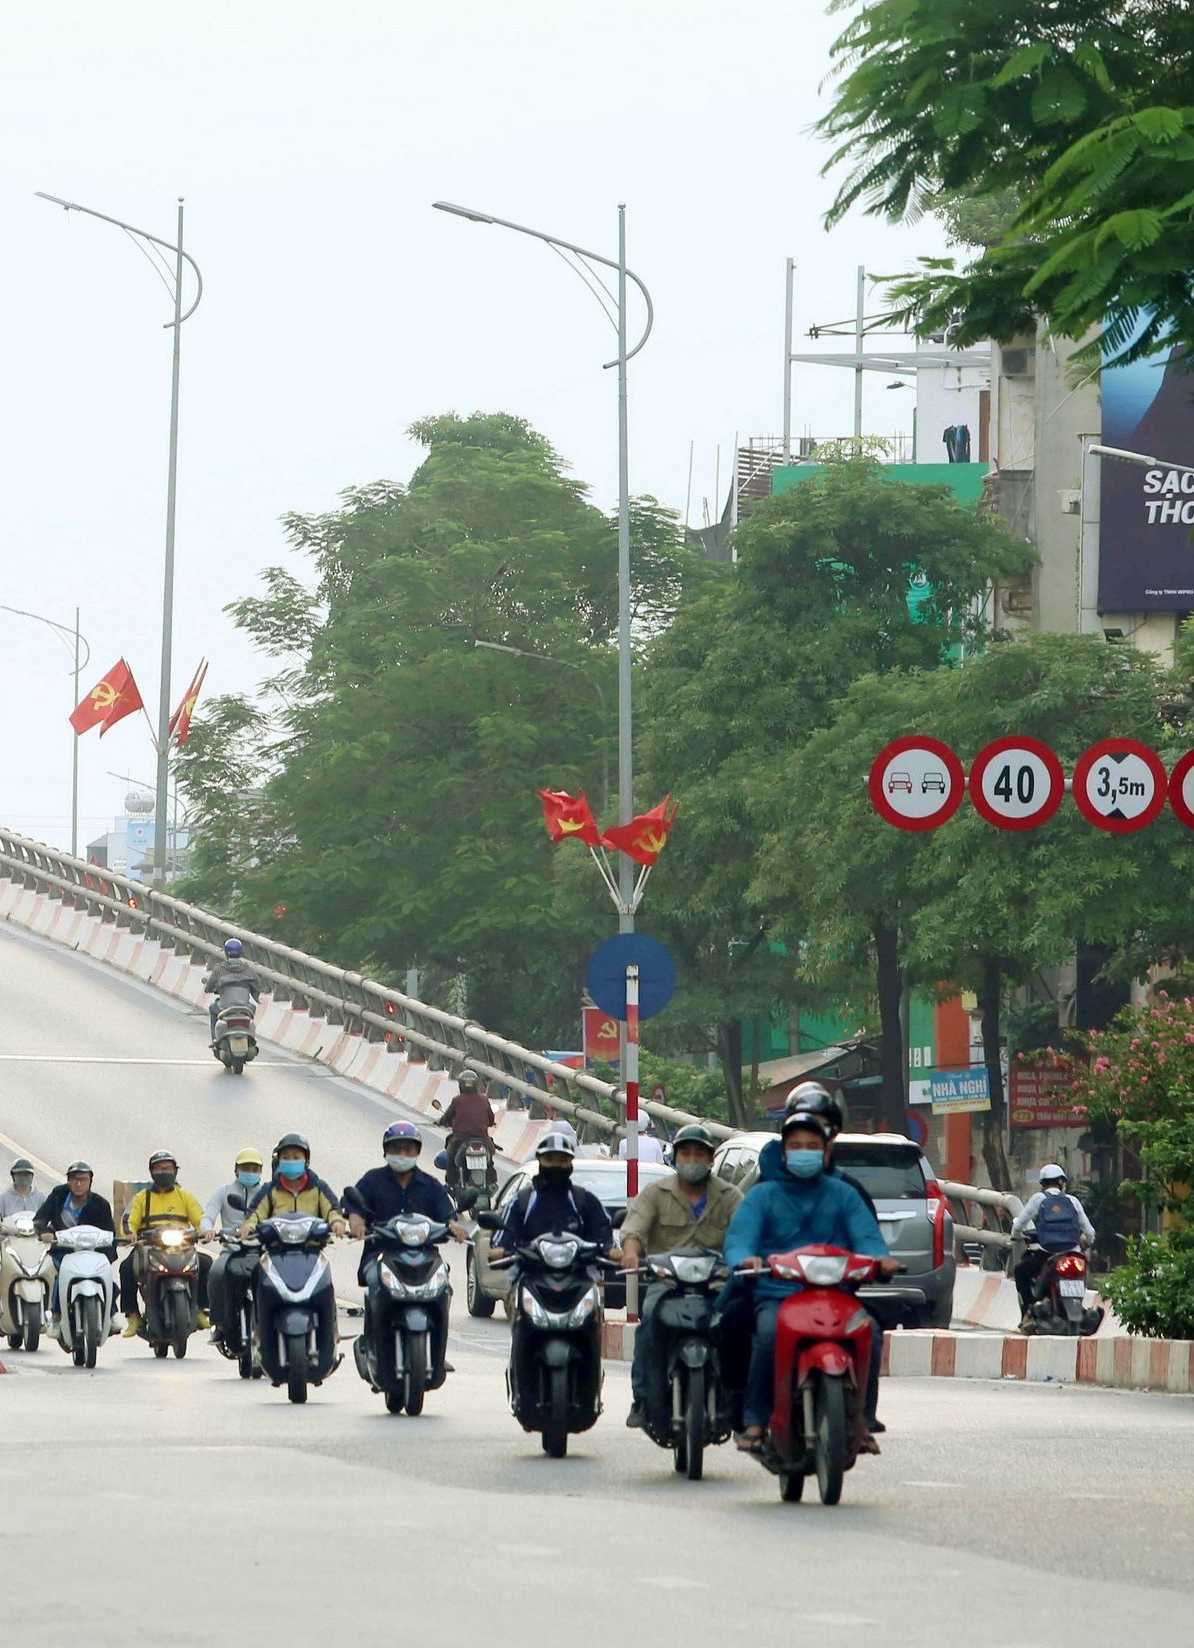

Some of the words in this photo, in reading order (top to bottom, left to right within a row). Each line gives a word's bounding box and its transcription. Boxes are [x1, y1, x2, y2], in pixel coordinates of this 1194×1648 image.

[994, 765, 1035, 803] 40
[1097, 767, 1145, 805] 3,5m
[932, 1080, 957, 1097] NHÀ
[959, 1075, 987, 1095] NGHỈ
